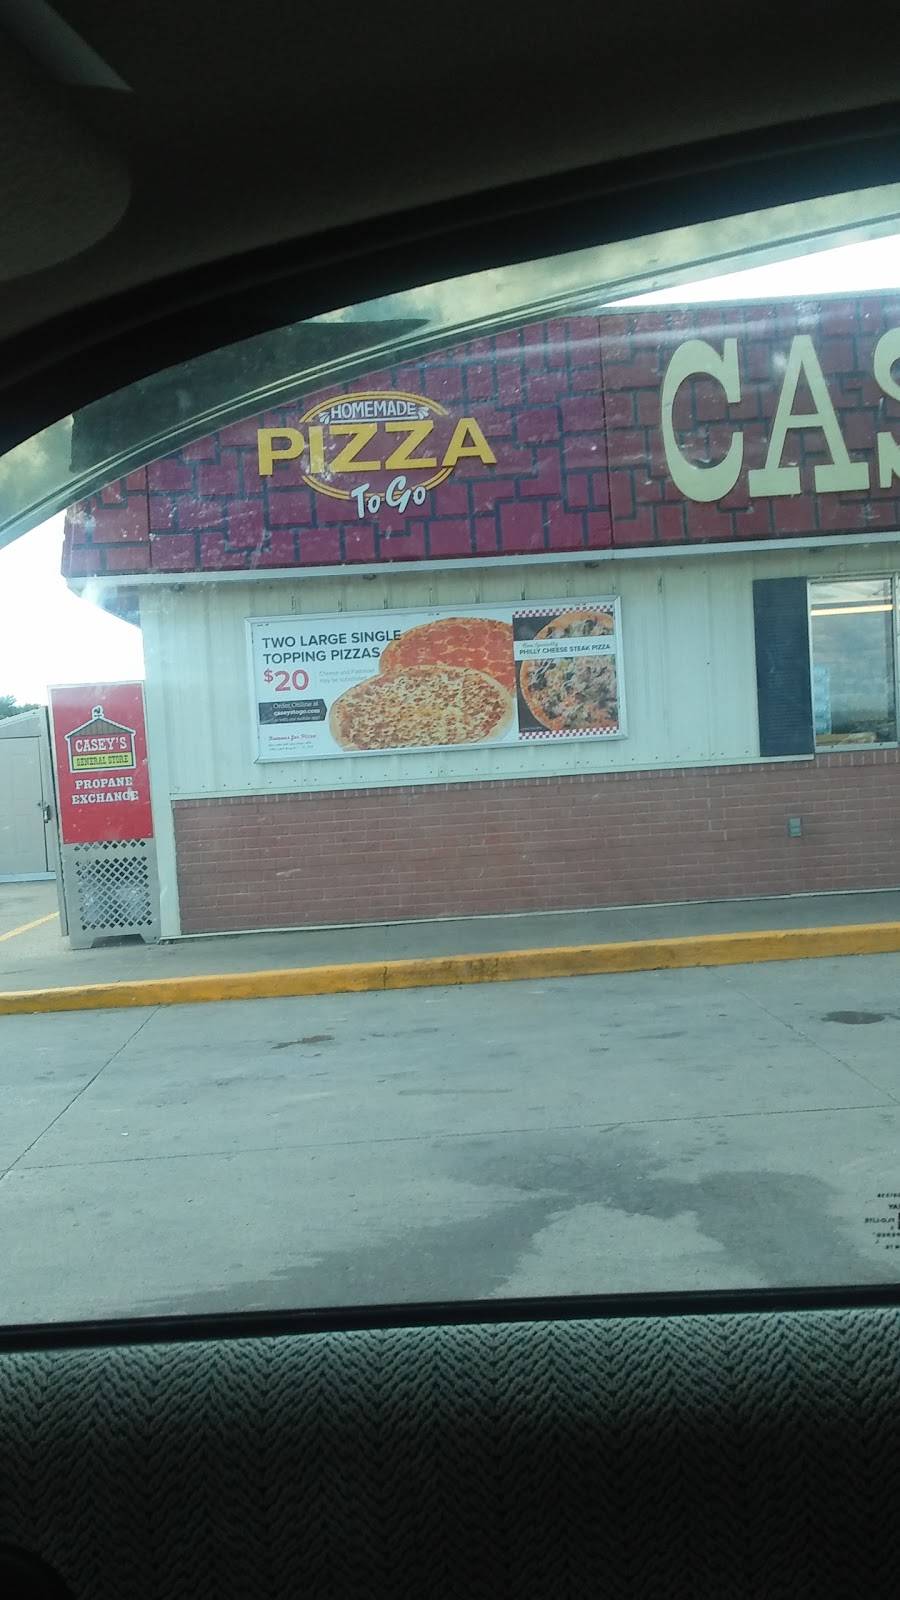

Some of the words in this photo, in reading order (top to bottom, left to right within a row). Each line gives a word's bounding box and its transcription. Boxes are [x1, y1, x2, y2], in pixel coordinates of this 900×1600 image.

[330, 401, 417, 419] HOMEMADE
[257, 417, 497, 476] PIZZA
[351, 482, 381, 519] To
[385, 475, 427, 513] Go
[262, 636, 296, 648] TWO
[300, 633, 347, 646] LARGE
[351, 629, 402, 643] SINGLE
[263, 650, 326, 664] TOPPING
[331, 647, 381, 661] PIZZAS
[263, 668, 309, 692] $20
[75, 737, 127, 752] CASEY'S
[75, 777, 133, 789] PROPANE
[72, 791, 139, 804] EXCHANGE
